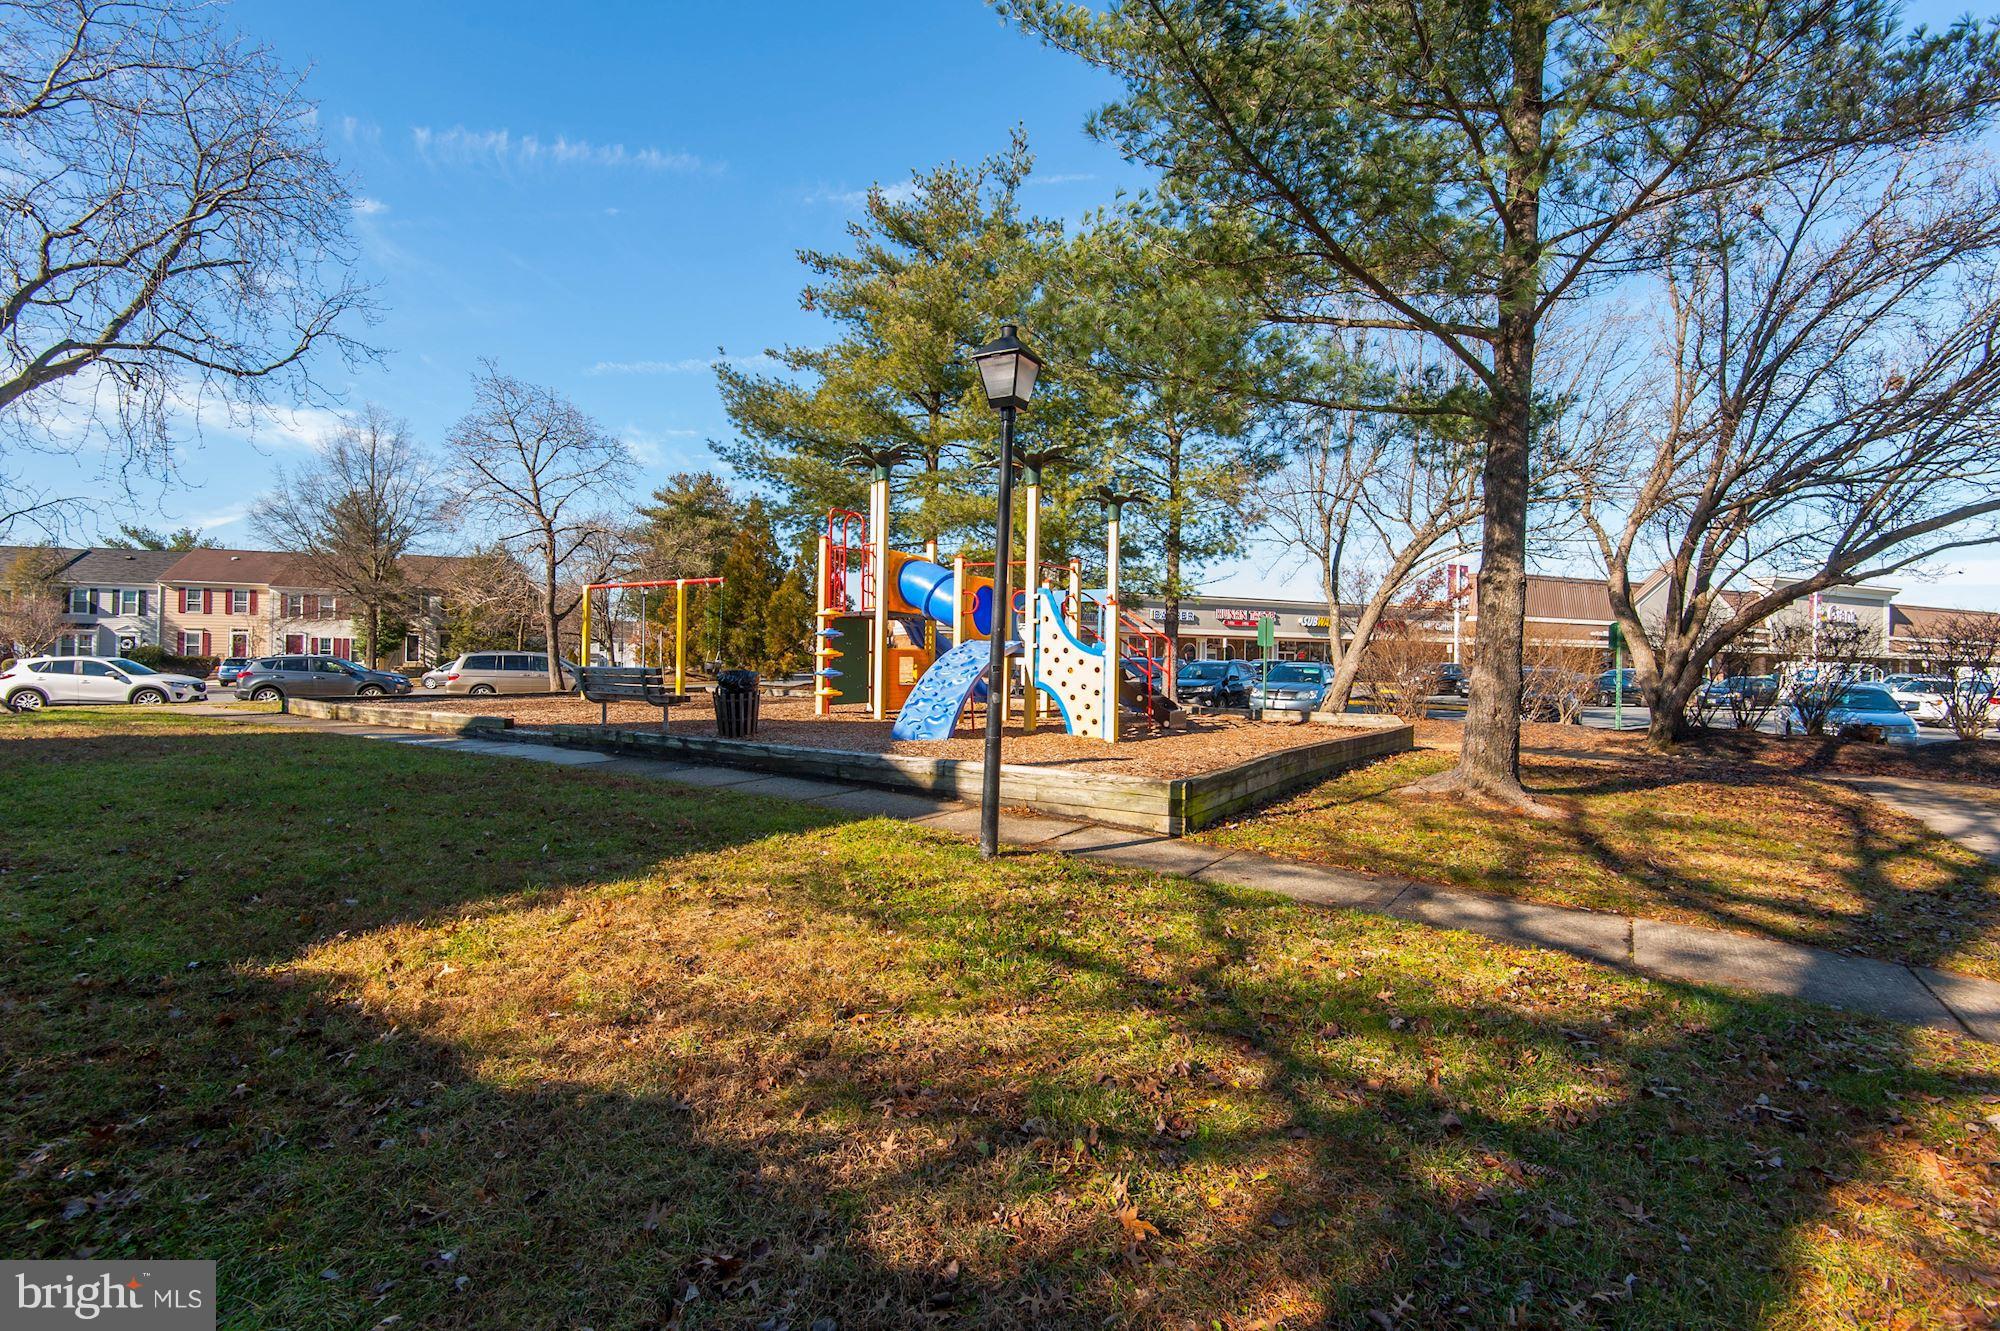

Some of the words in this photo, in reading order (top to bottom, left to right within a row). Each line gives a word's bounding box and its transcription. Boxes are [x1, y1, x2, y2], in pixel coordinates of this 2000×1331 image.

[1154, 609, 1195, 621] BAER
[1215, 608, 1248, 620] HUNAN
[1828, 605, 1857, 623] Giant
[1298, 615, 1331, 627] SUBWA
